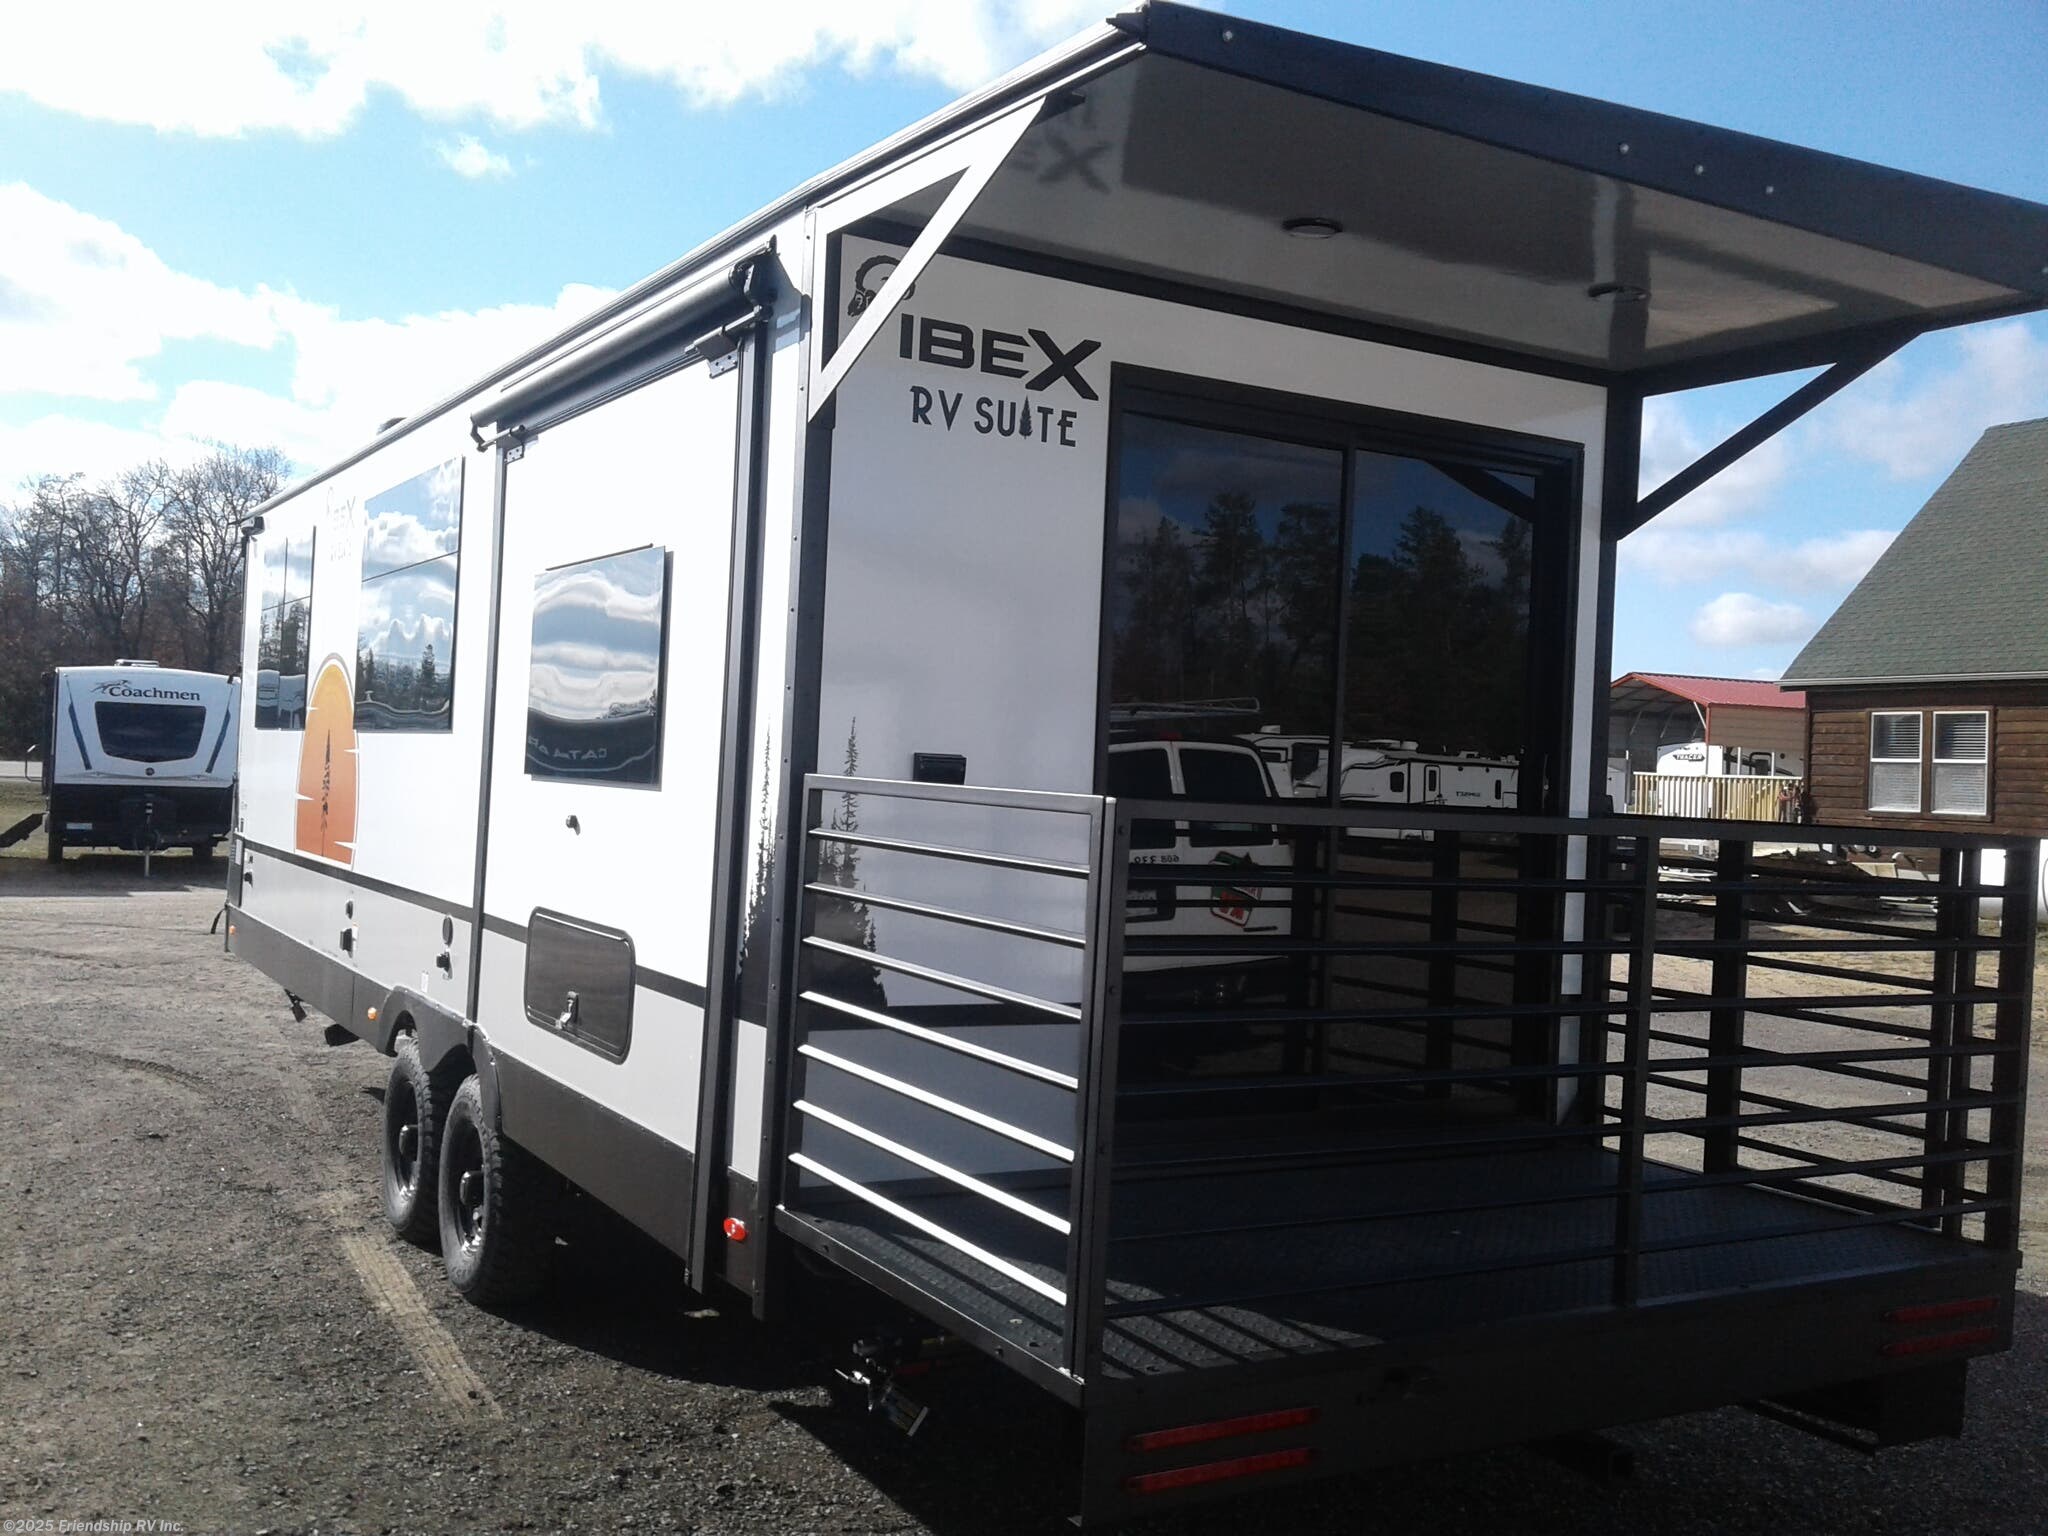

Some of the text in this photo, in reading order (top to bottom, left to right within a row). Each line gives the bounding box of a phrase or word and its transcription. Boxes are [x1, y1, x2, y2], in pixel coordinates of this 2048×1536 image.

[899, 312, 1102, 401] IBEX
[909, 385, 1078, 447] RV SUITE
[109, 685, 200, 701] Coachmen
